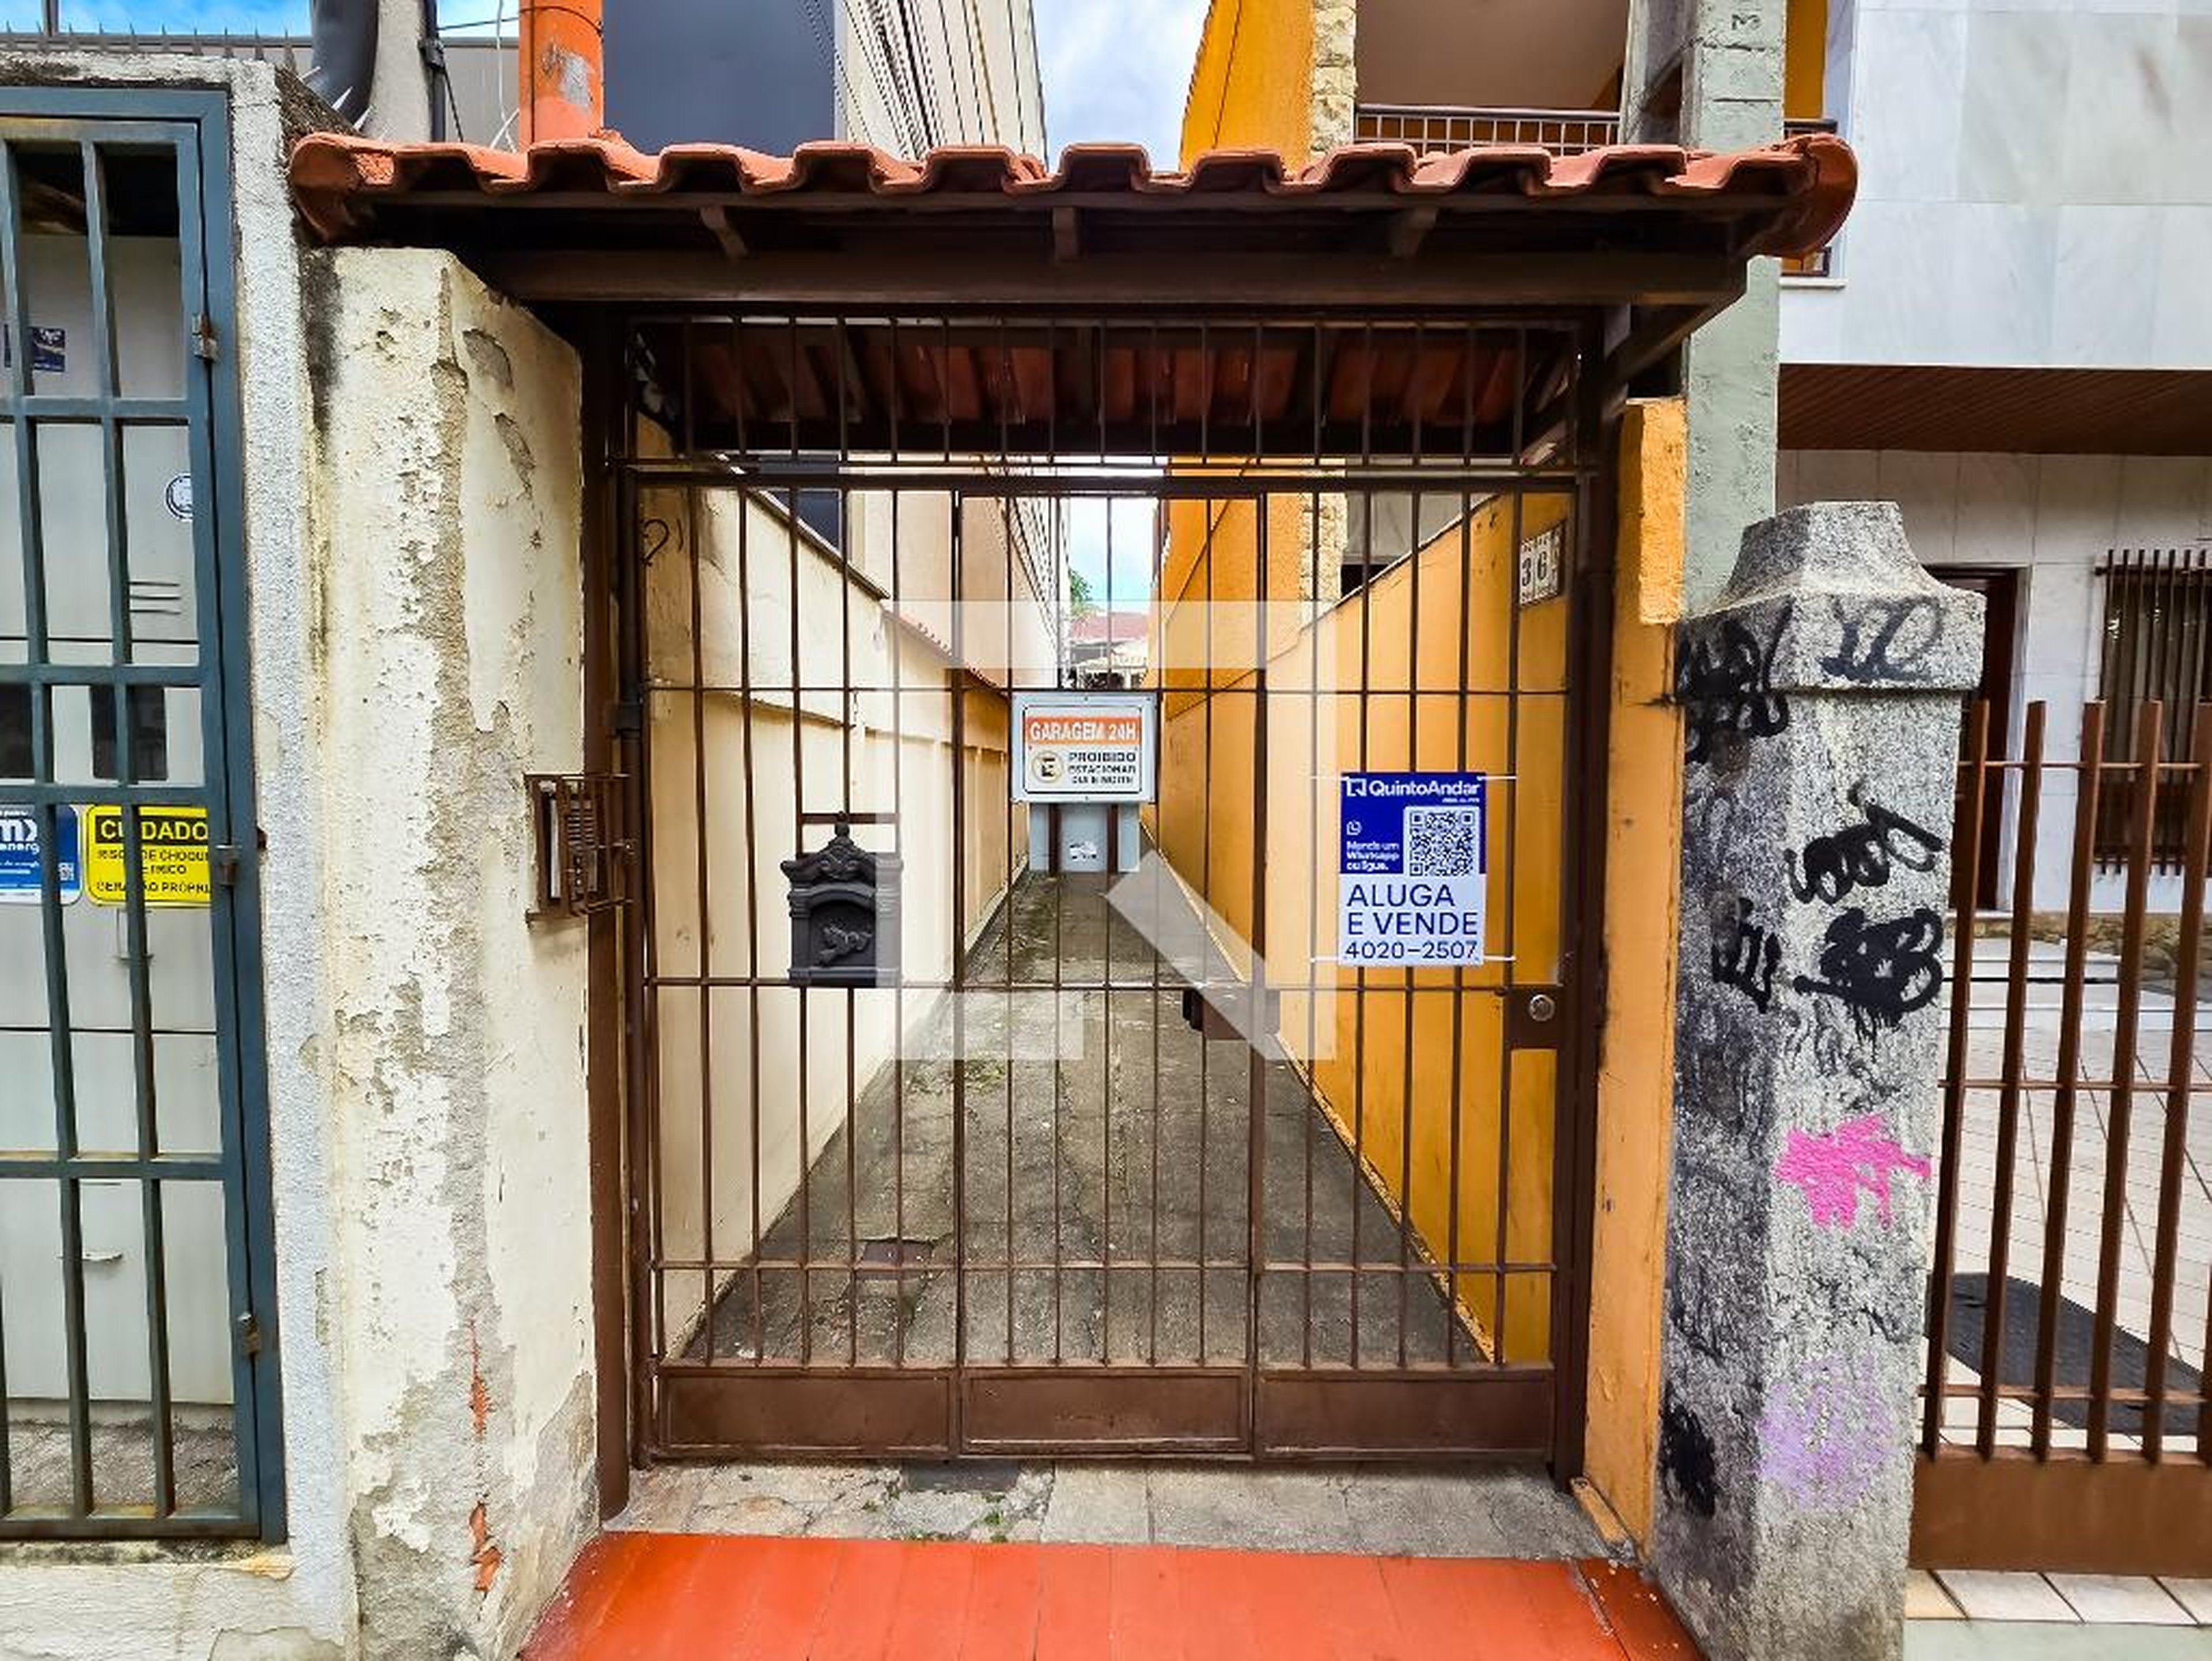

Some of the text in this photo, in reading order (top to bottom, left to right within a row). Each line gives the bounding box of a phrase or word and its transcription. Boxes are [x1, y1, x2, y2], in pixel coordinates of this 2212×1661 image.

[1030, 721, 1137, 741] GARAGEM 24H
[1069, 752, 1136, 762] PROIBIDO
[1067, 765, 1136, 774] ESTACIONAR
[1369, 780, 1480, 797] QuintoAndar
[101, 820, 208, 840] CDADO
[1346, 884, 1456, 907] ALUGA
[1348, 912, 1478, 935] E VENDE
[1345, 940, 1478, 959] 4020-2507
